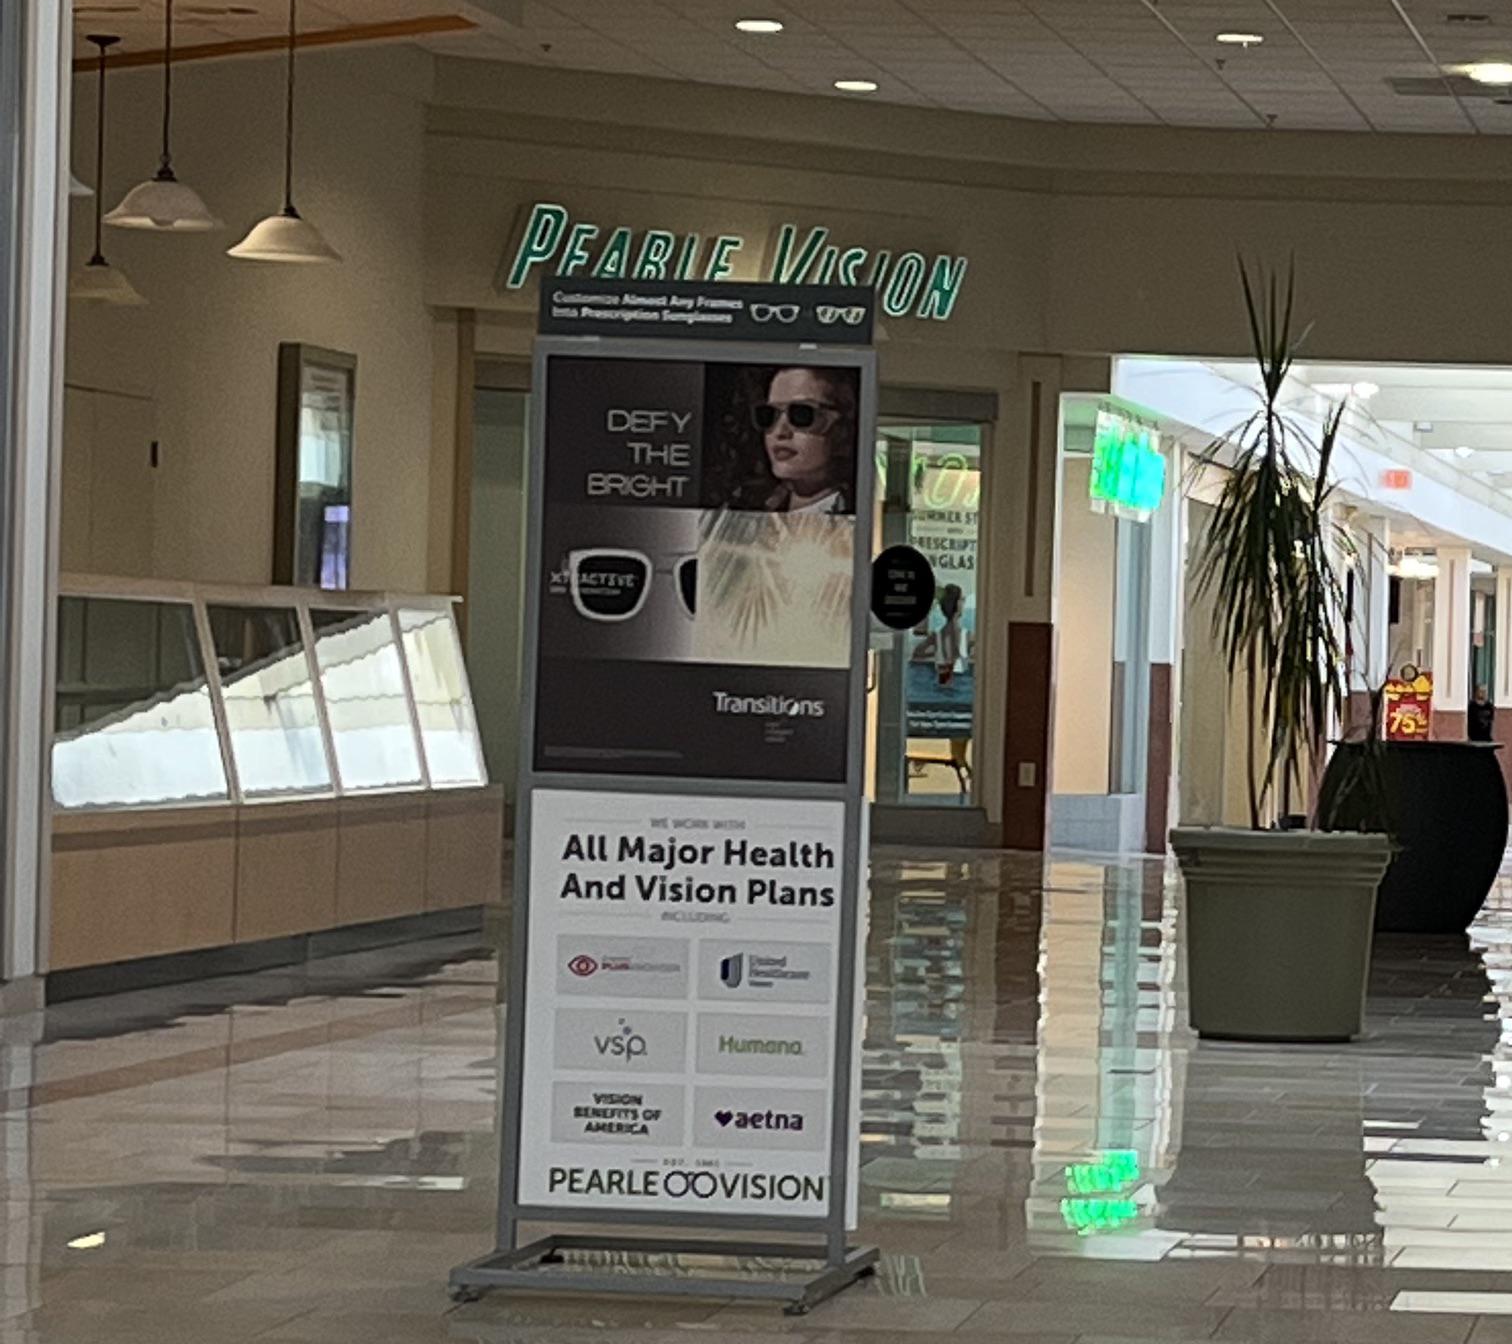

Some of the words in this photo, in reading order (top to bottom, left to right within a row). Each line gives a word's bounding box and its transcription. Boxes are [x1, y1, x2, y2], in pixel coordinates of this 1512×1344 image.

[608, 410, 692, 433] DEFY
[627, 442, 690, 466] THE
[587, 473, 689, 497] BRIGHT
[712, 691, 825, 717] Transitions
[561, 834, 608, 862] All
[617, 836, 715, 870] Major
[724, 839, 834, 869] Health
[560, 872, 626, 900] And
[635, 874, 737, 904] Vision
[747, 878, 835, 907] Plans
[593, 1093, 643, 1106] VISION
[573, 1105, 639, 1120] BENEFITS
[642, 1109, 662, 1122] OF
[734, 1109, 804, 1131] aetna
[584, 1122, 649, 1136] AMERICA
[549, 1167, 660, 1197] PEARLE
[720, 1172, 825, 1202] VISION
